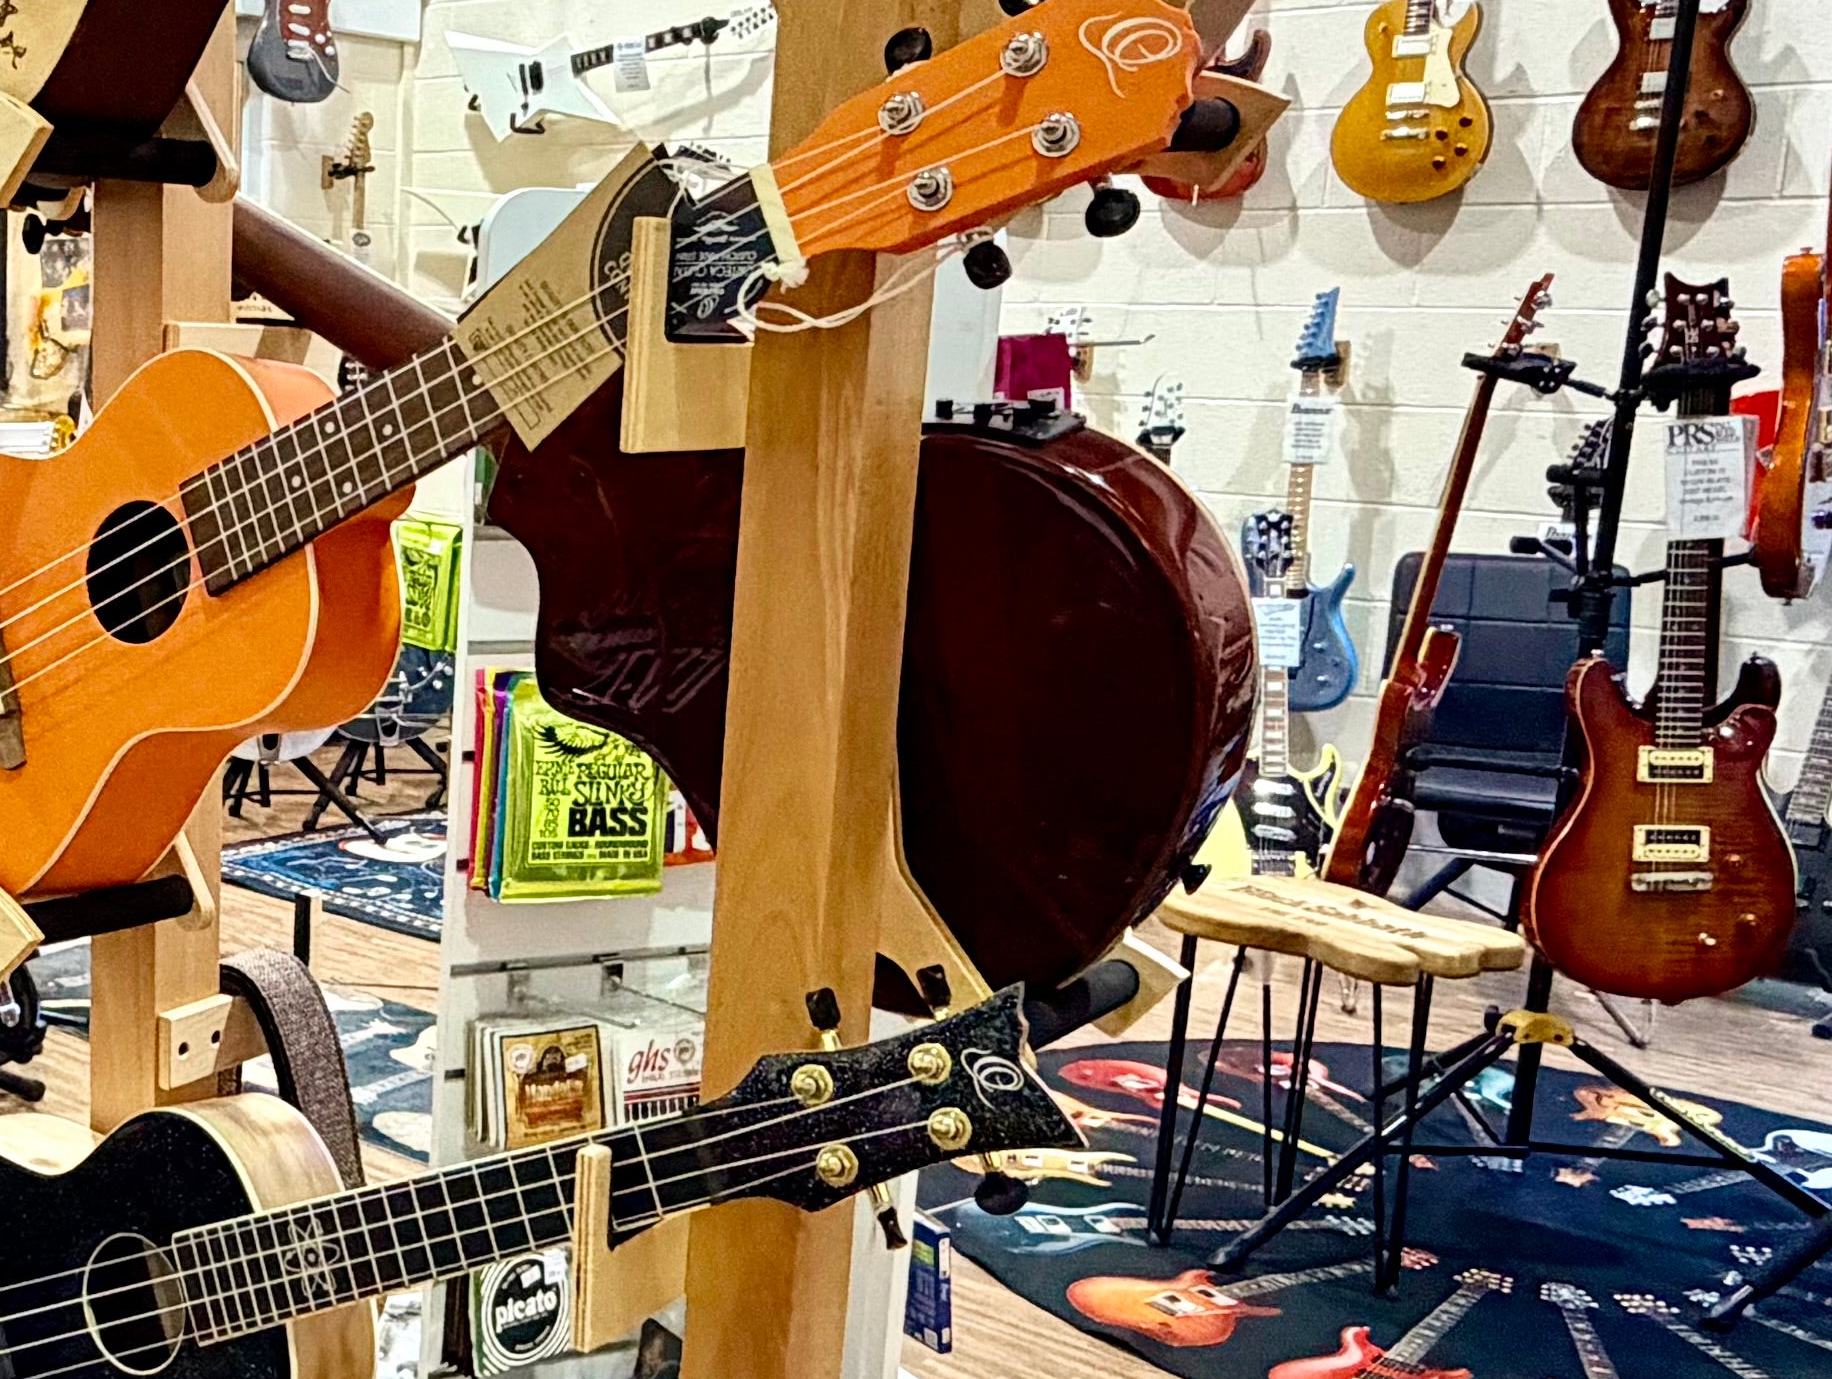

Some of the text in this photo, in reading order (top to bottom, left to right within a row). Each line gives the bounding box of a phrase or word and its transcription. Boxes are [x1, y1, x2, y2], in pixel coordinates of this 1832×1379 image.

[1666, 423, 1716, 447] PRS
[576, 762, 649, 781] REGULAR
[571, 781, 654, 808] SLINKY
[567, 806, 649, 838] BASS
[627, 1038, 672, 1085] ghs
[495, 1288, 558, 1334] picato
